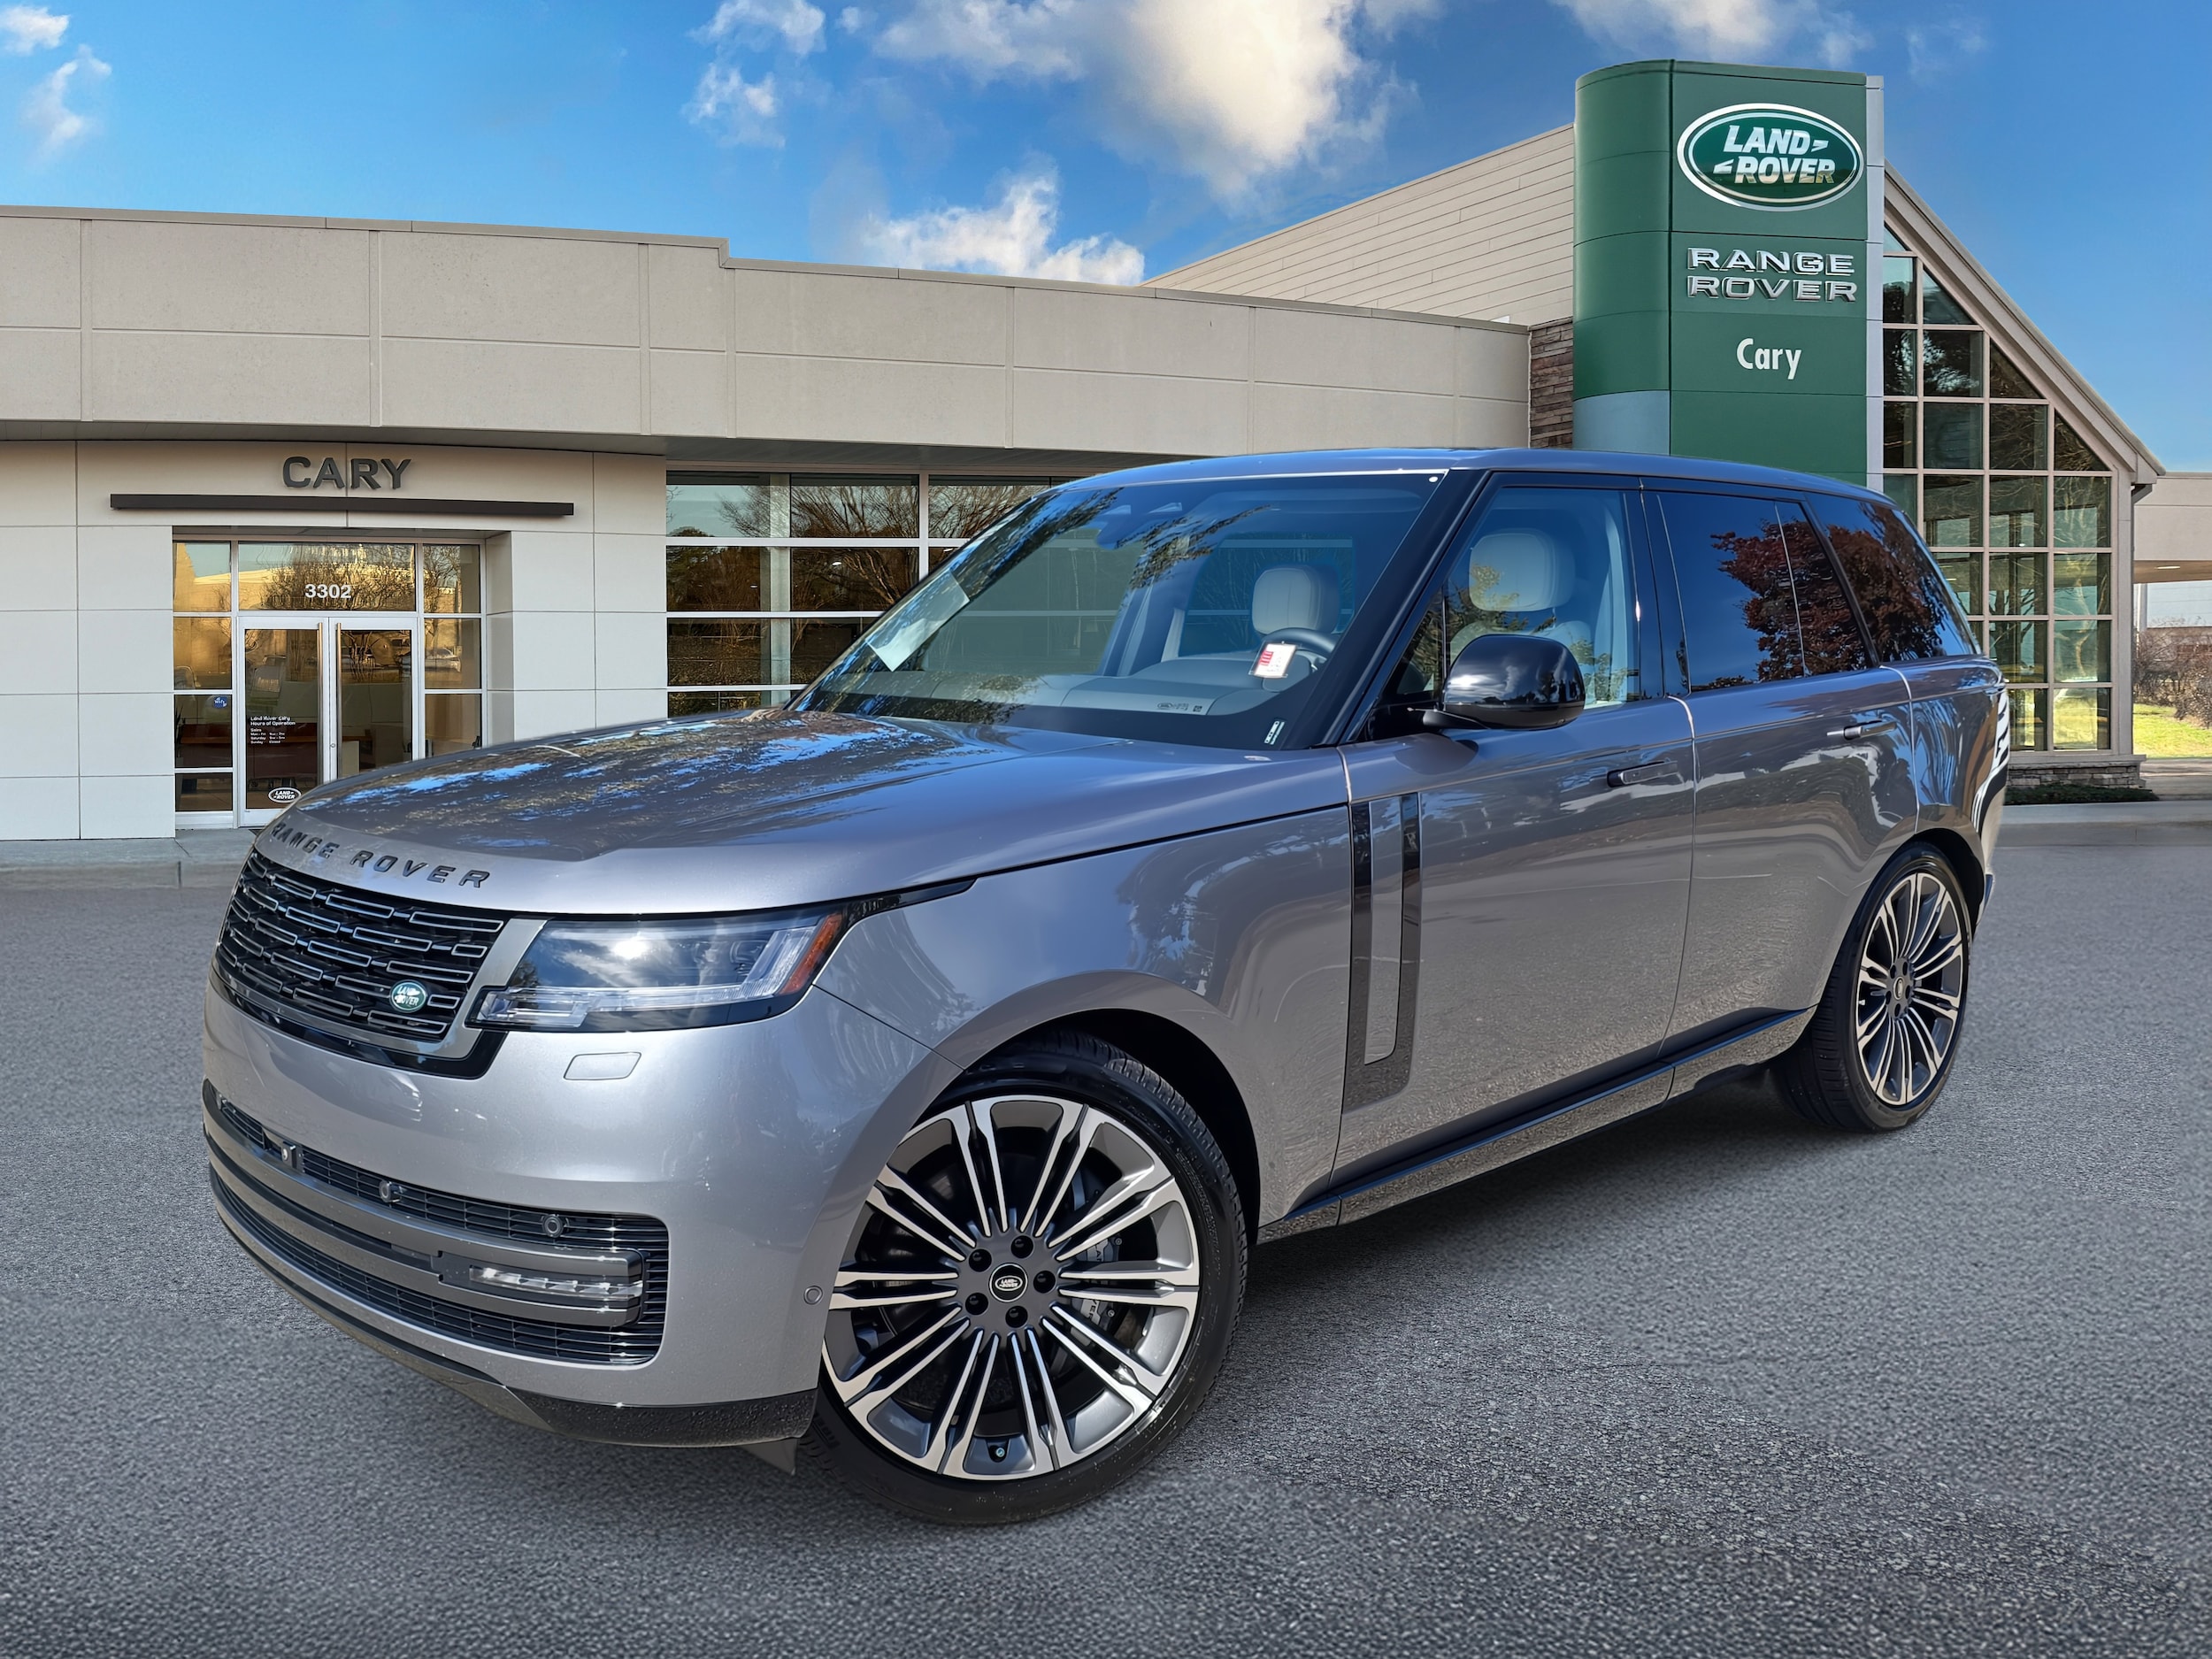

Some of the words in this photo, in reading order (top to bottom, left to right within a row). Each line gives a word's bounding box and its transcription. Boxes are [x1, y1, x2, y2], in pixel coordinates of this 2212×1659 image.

[1723, 125, 1811, 154] LAND
[1734, 156, 1836, 184] ROVER
[1686, 247, 1856, 275] RANGE
[1686, 275, 1857, 303] ROVER
[1736, 338, 1802, 380] Cary
[282, 456, 411, 490] CARY
[304, 584, 352, 599] 3302
[269, 823, 340, 859] RANGE
[349, 849, 491, 888] ROVER
